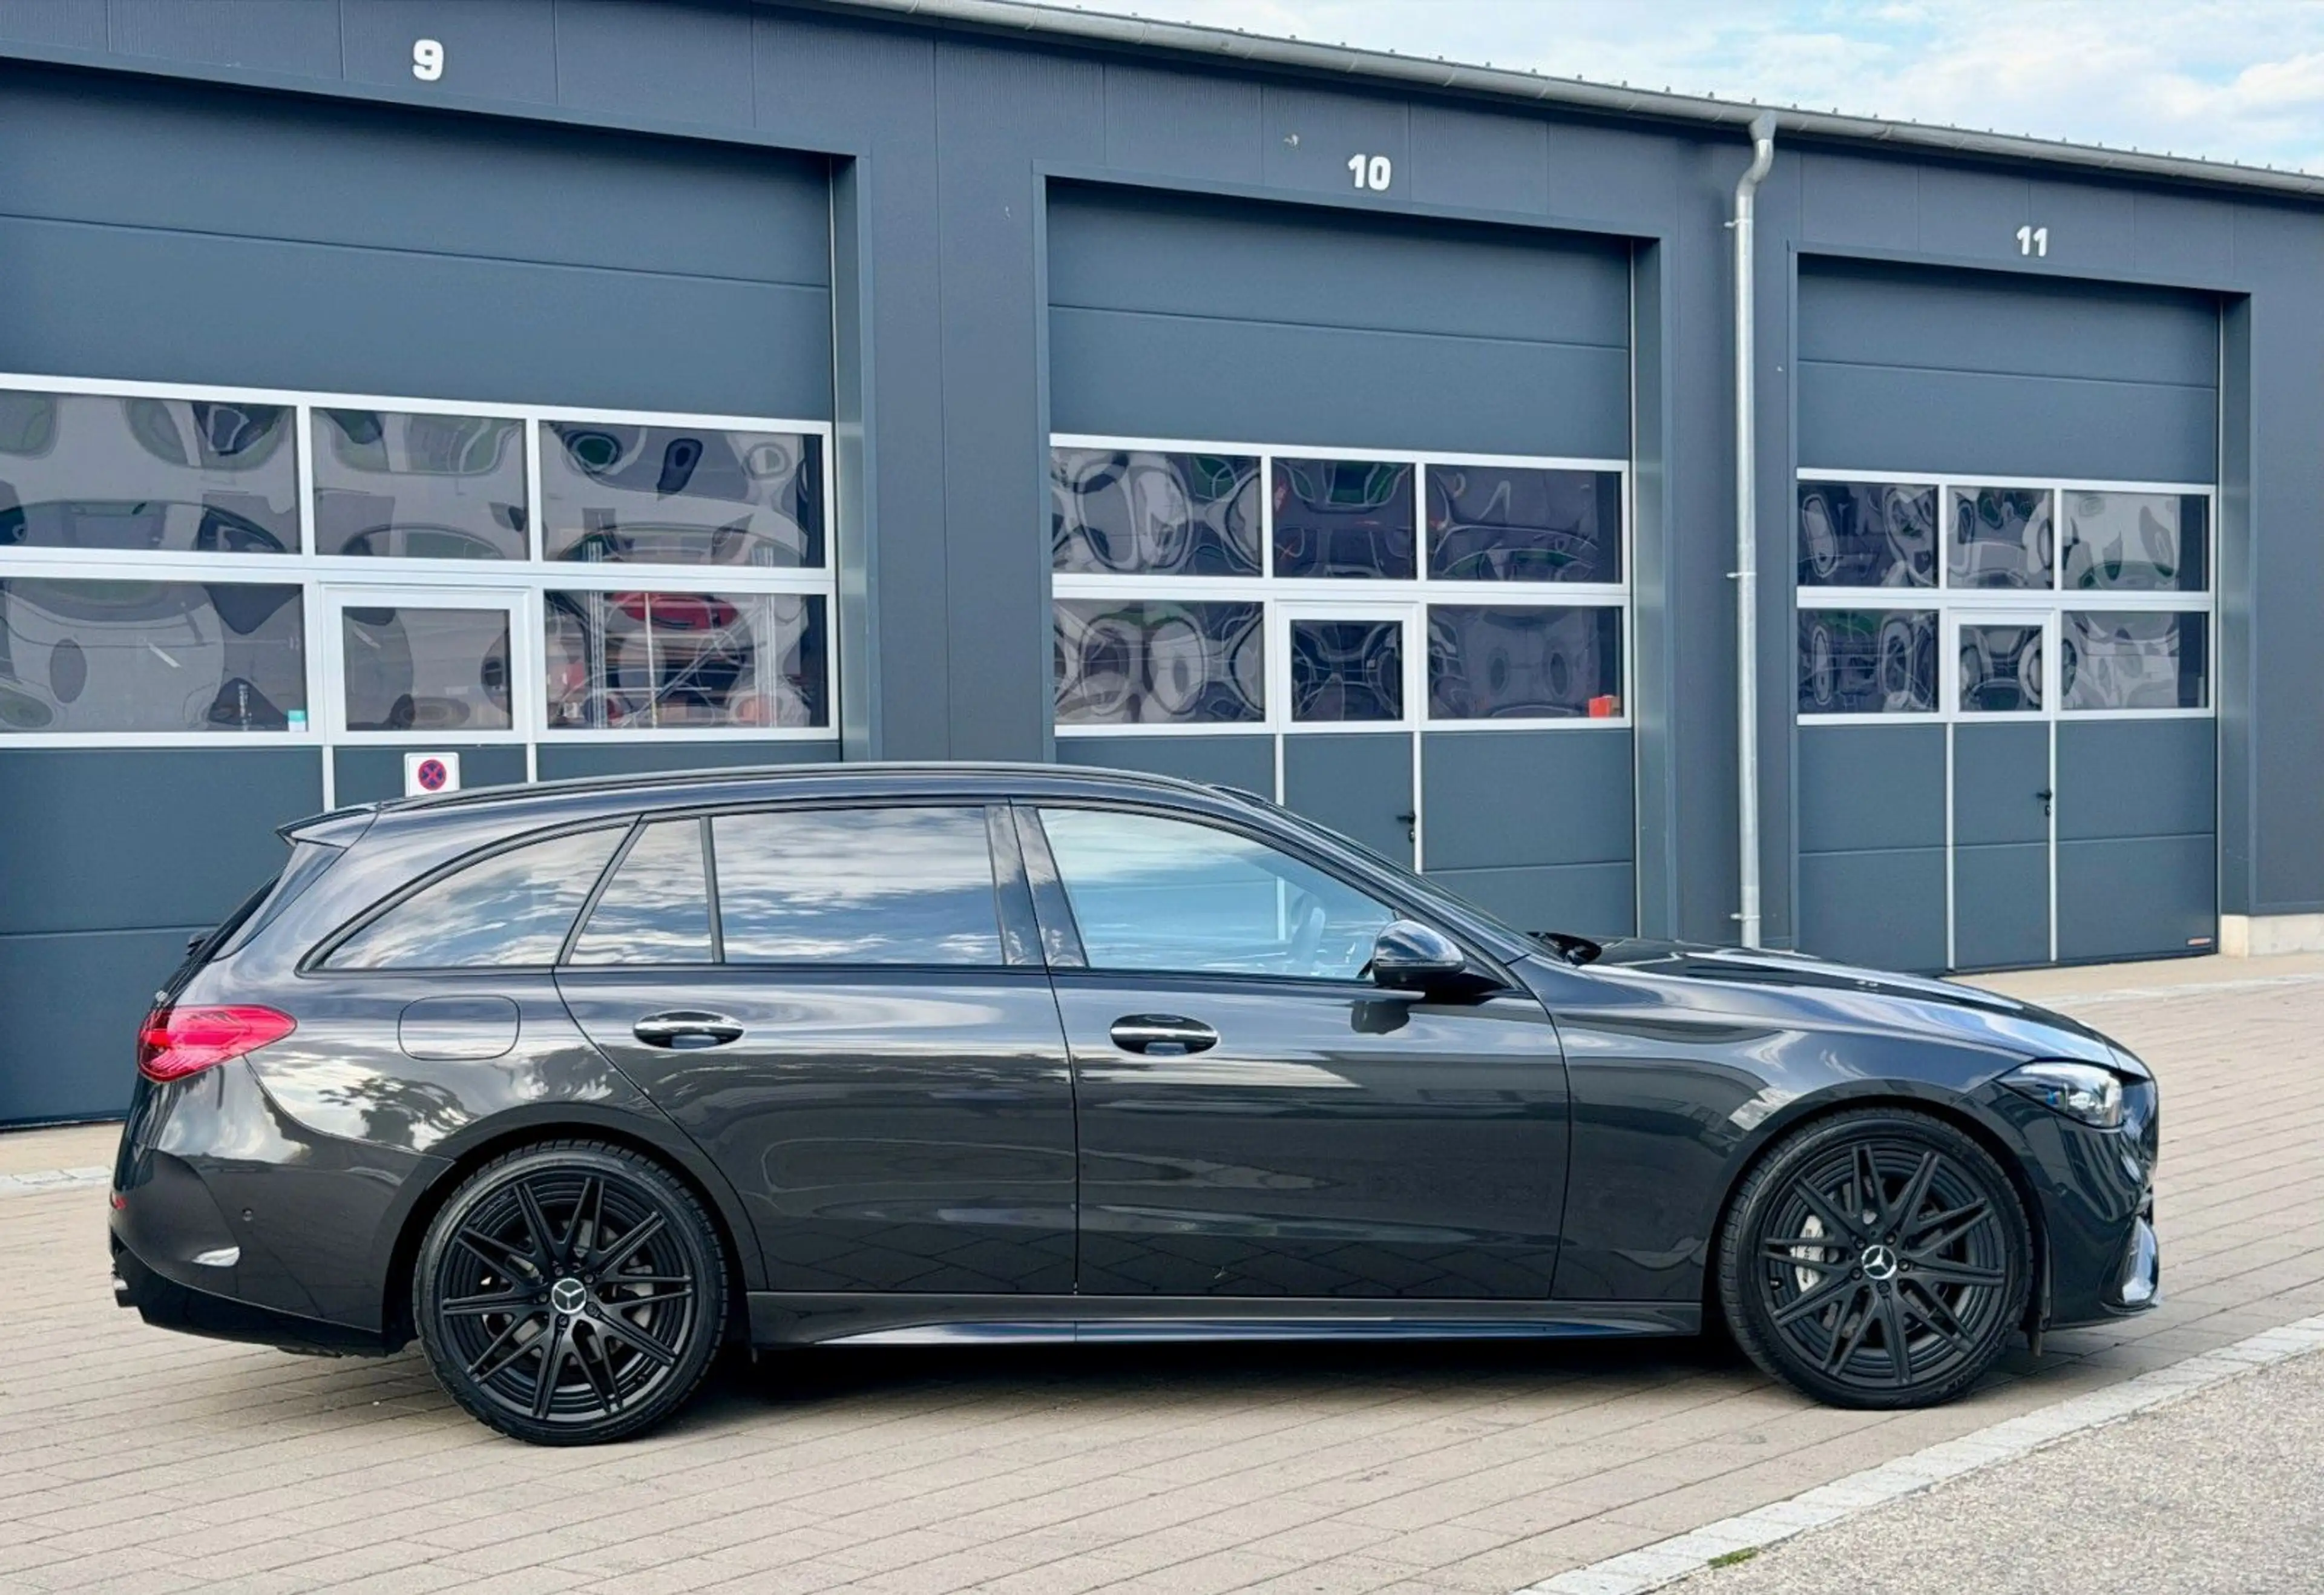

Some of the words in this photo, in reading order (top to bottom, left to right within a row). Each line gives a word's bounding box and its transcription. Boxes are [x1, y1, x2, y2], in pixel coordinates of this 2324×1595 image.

[413, 39, 444, 81] 9
[1348, 154, 1391, 191] 10
[2017, 226, 2047, 257] 11
